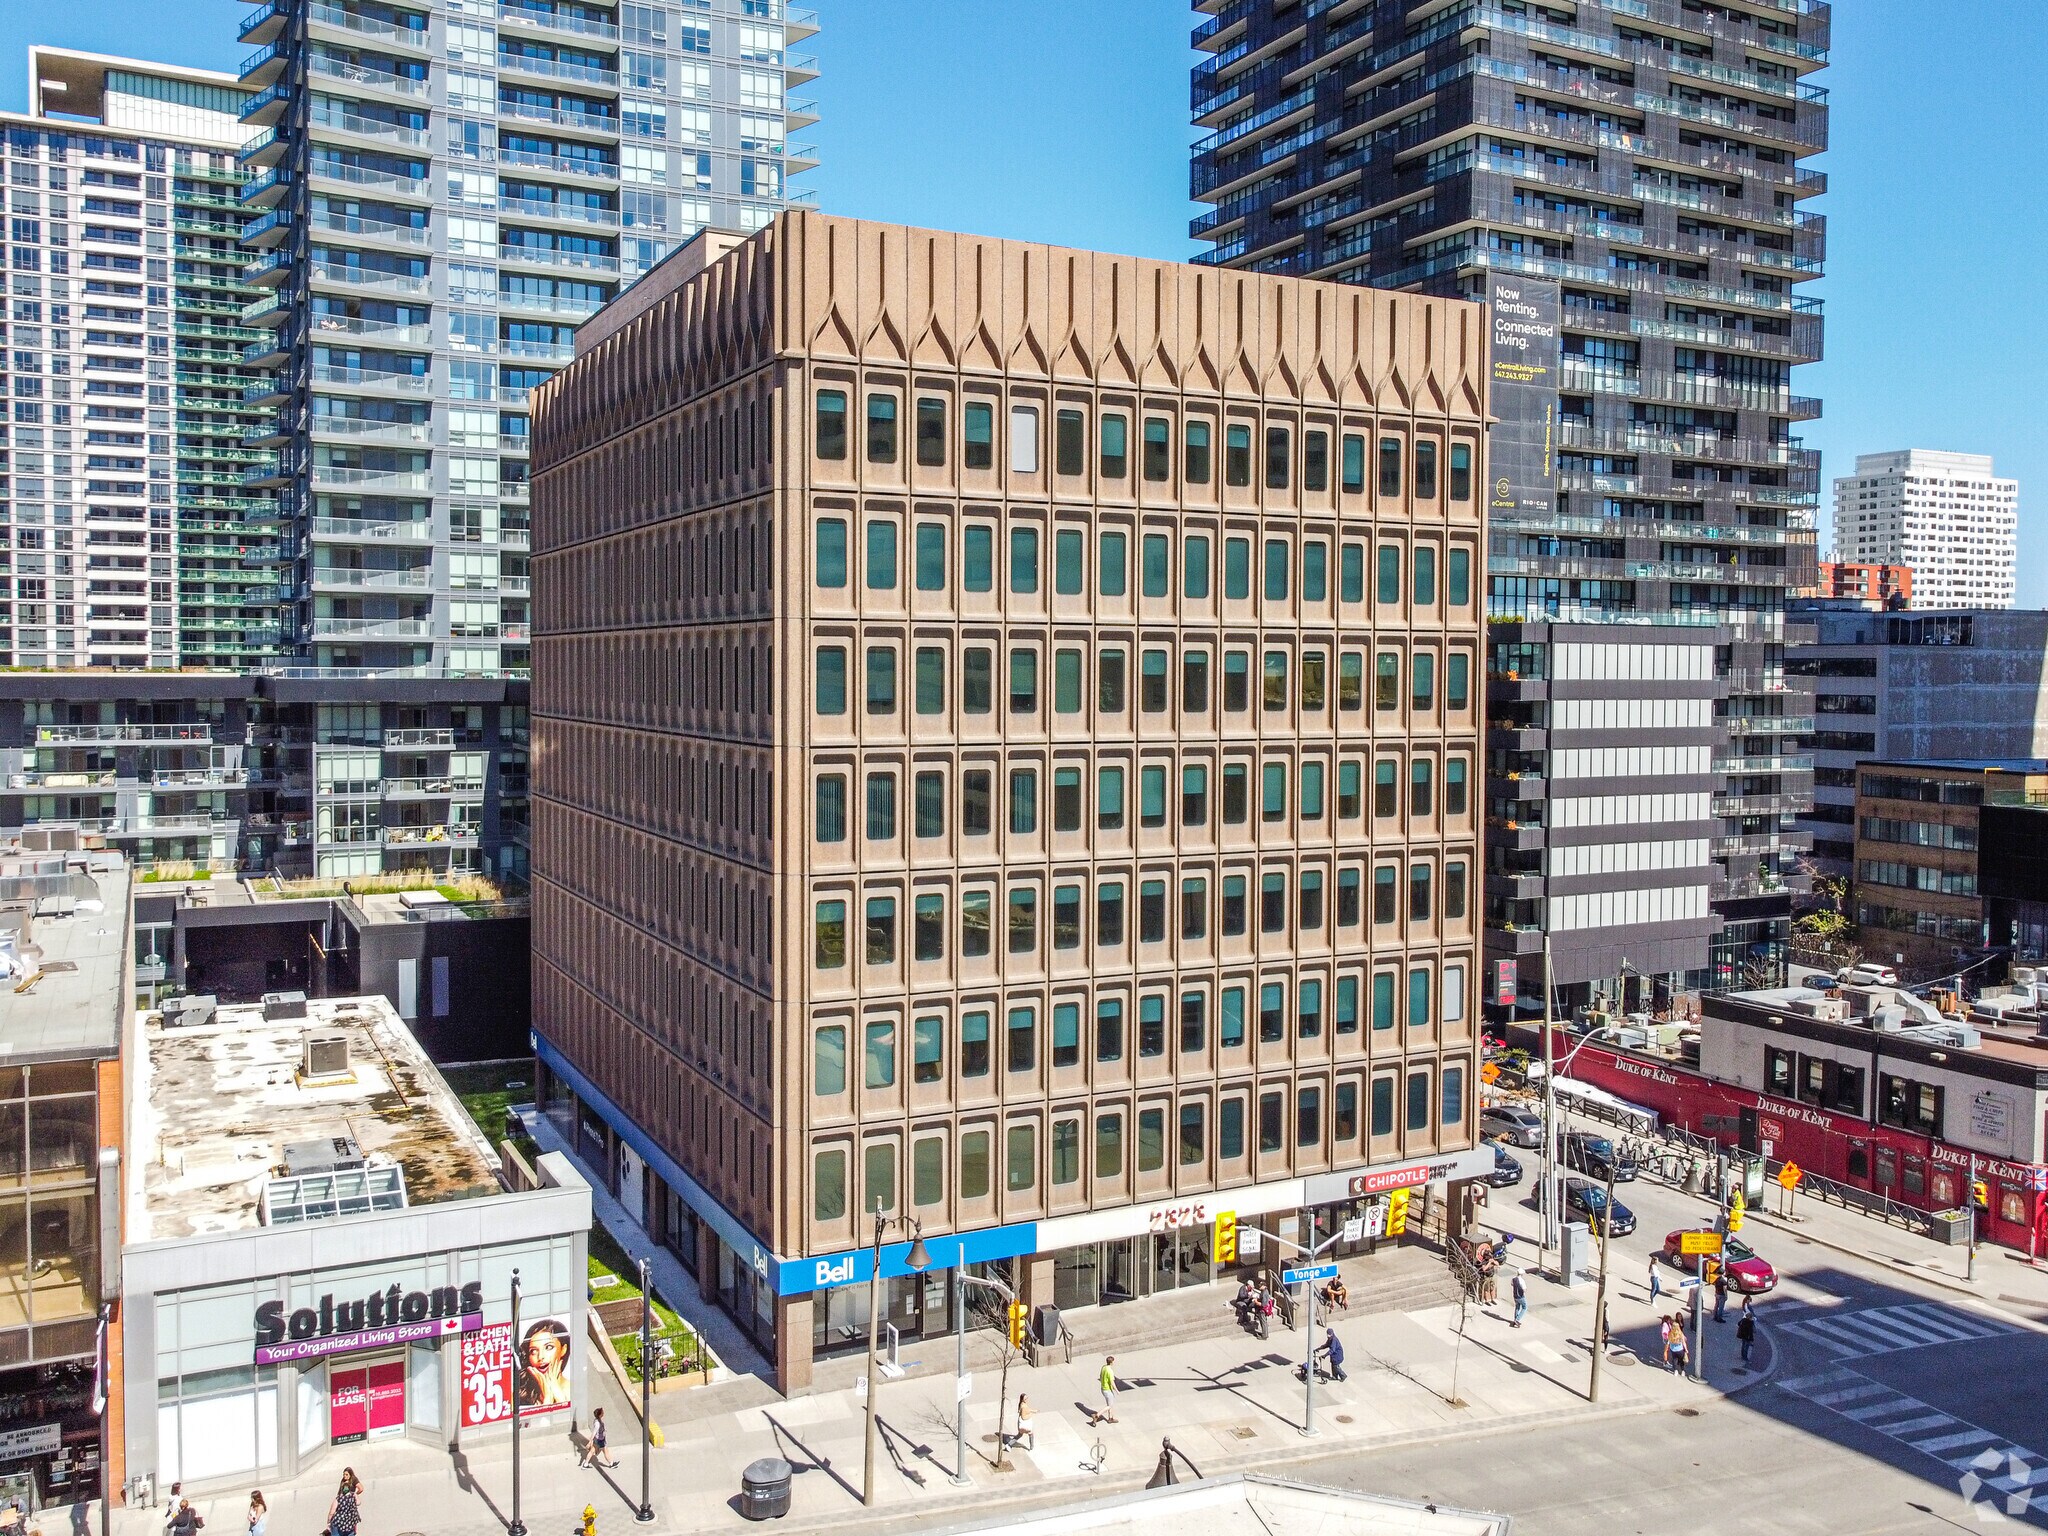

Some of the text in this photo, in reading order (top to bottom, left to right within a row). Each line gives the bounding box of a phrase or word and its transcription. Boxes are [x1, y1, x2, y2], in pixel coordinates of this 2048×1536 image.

[1496, 285, 1520, 300] Now
[1496, 299, 1540, 319] Renting.
[1495, 318, 1554, 337] Connected
[1495, 332, 1530, 350] Living.
[1494, 361, 1547, 374] eCentralLiving.com
[1494, 370, 1534, 381] 647.243.9327
[1491, 499, 1516, 508] eCentral
[1615, 1056, 1678, 1086] DUKE OF KENT
[1757, 1097, 1787, 1117] DUKE
[1787, 1106, 1802, 1119] OF
[1801, 1108, 1833, 1129] KENT
[1931, 1144, 1968, 1167] DUKE
[1970, 1157, 1987, 1171] OF
[1986, 1160, 2025, 1182] KENT
[1367, 1168, 1427, 1189] CHIPOTLE
[754, 1245, 768, 1279] Bell
[816, 1256, 853, 1285] Bell
[1293, 1268, 1321, 1280] Yonge
[254, 1281, 483, 1344] Solutions
[266, 1324, 432, 1359] Your Organized Living Store
[463, 1325, 511, 1342] KITCHEN
[463, 1350, 511, 1375] SALE
[332, 1393, 367, 1408] LEASE
[337, 1385, 360, 1397] FOR
